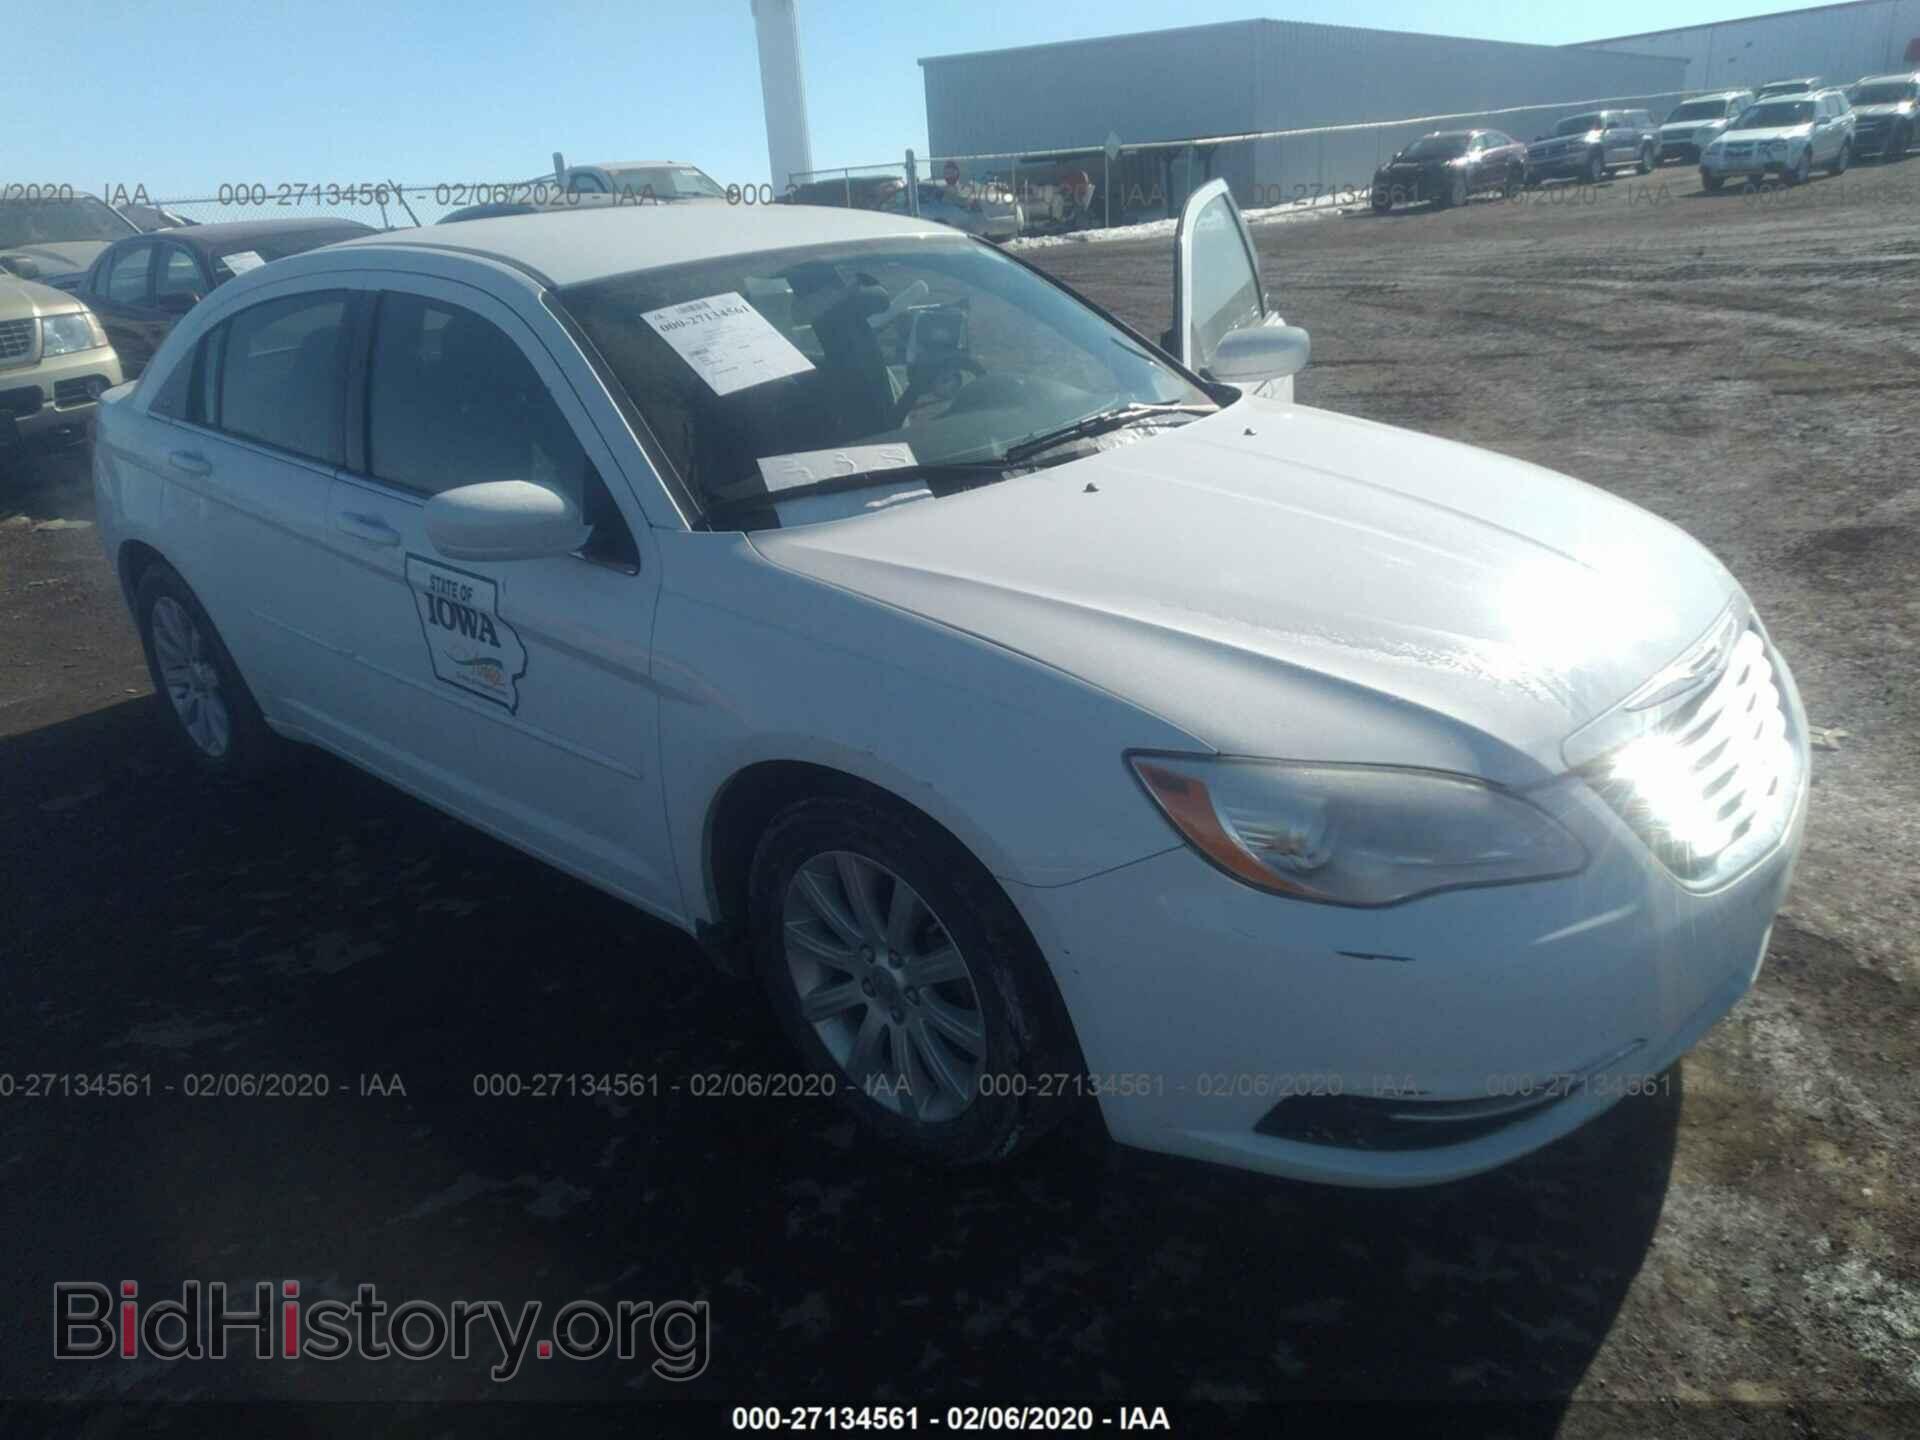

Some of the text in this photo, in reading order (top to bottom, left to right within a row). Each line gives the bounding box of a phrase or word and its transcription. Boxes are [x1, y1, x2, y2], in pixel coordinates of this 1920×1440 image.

[430, 574, 474, 602] STATE OF
[424, 592, 502, 648] IOWA
